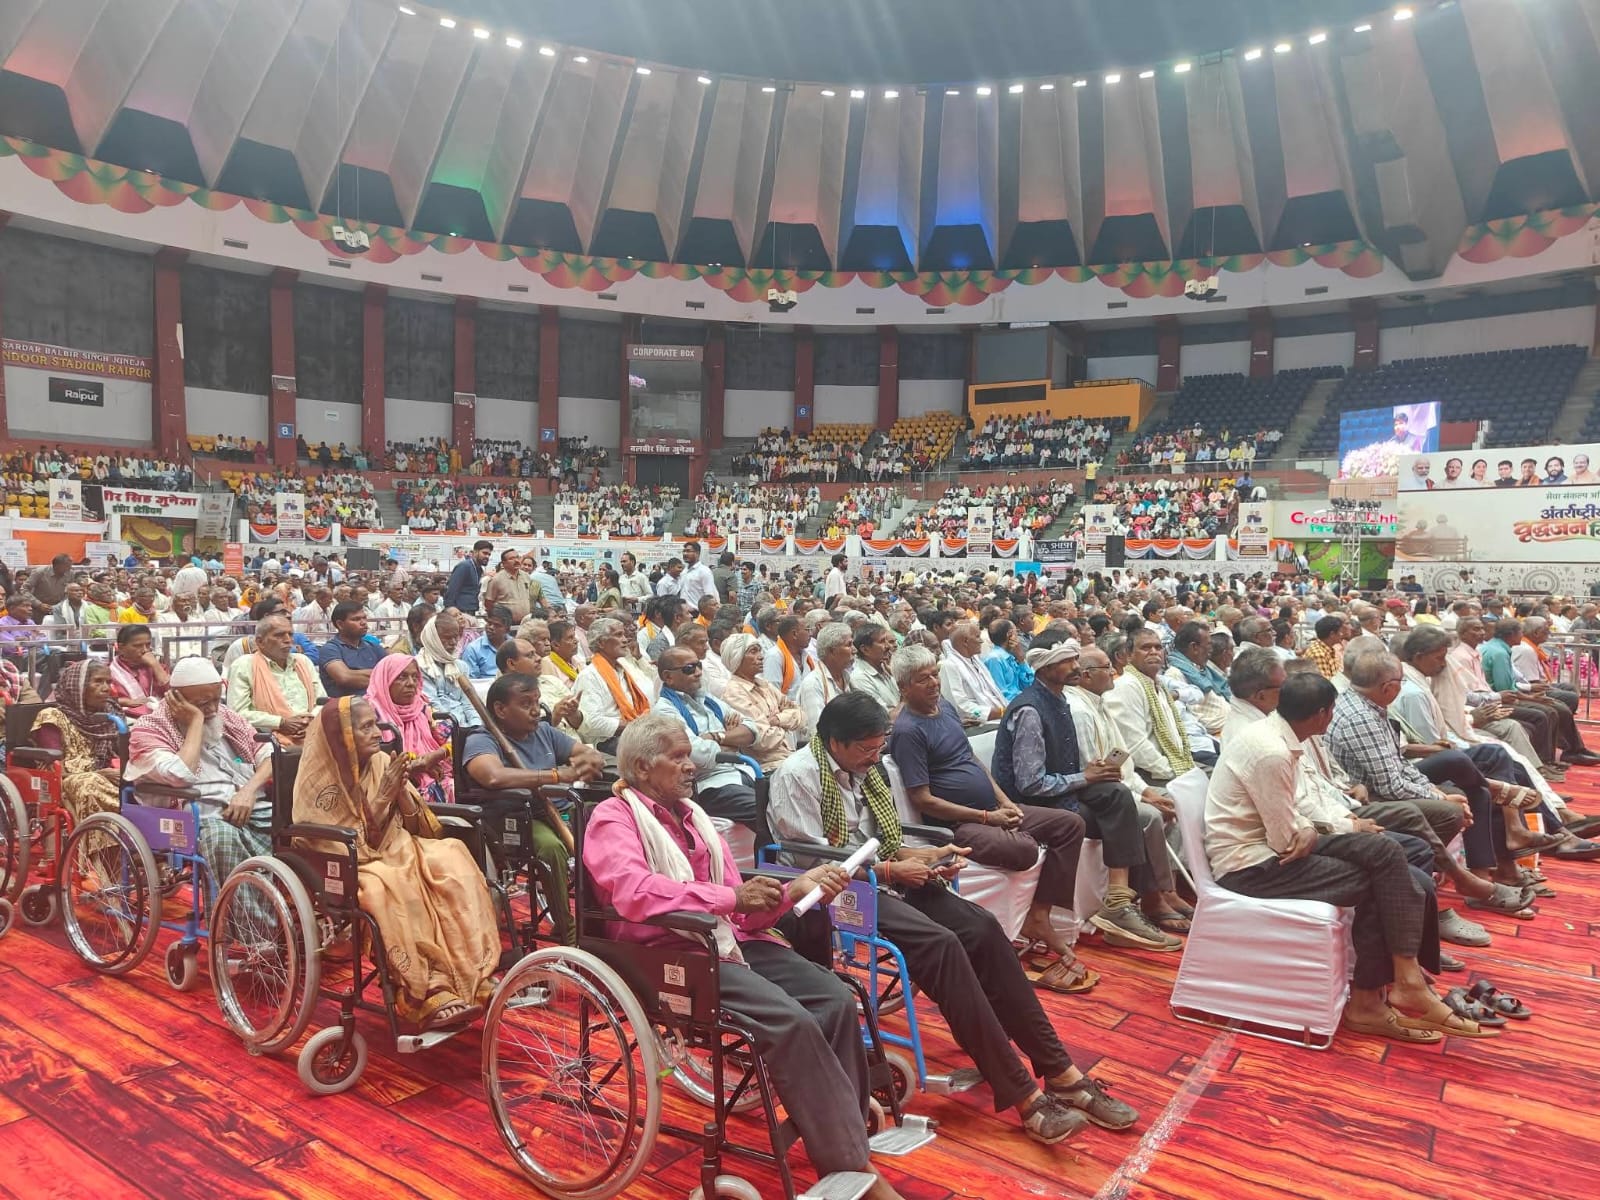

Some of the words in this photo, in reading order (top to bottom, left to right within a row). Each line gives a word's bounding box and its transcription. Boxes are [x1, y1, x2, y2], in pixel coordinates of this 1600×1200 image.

[2, 341, 41, 353] SARDAR
[45, 347, 79, 359] BALBIR
[82, 351, 109, 362] SINGH
[112, 356, 146, 367] JUNEJA
[633, 347, 677, 357] CORPORATE
[680, 349, 695, 357] BOX
[52, 356, 105, 373] STADIUM
[108, 364, 152, 379] RAIPUR
[65, 388, 99, 402] Raipur
[282, 426, 288, 435] 8
[155, 494, 198, 508] जुनेजा
